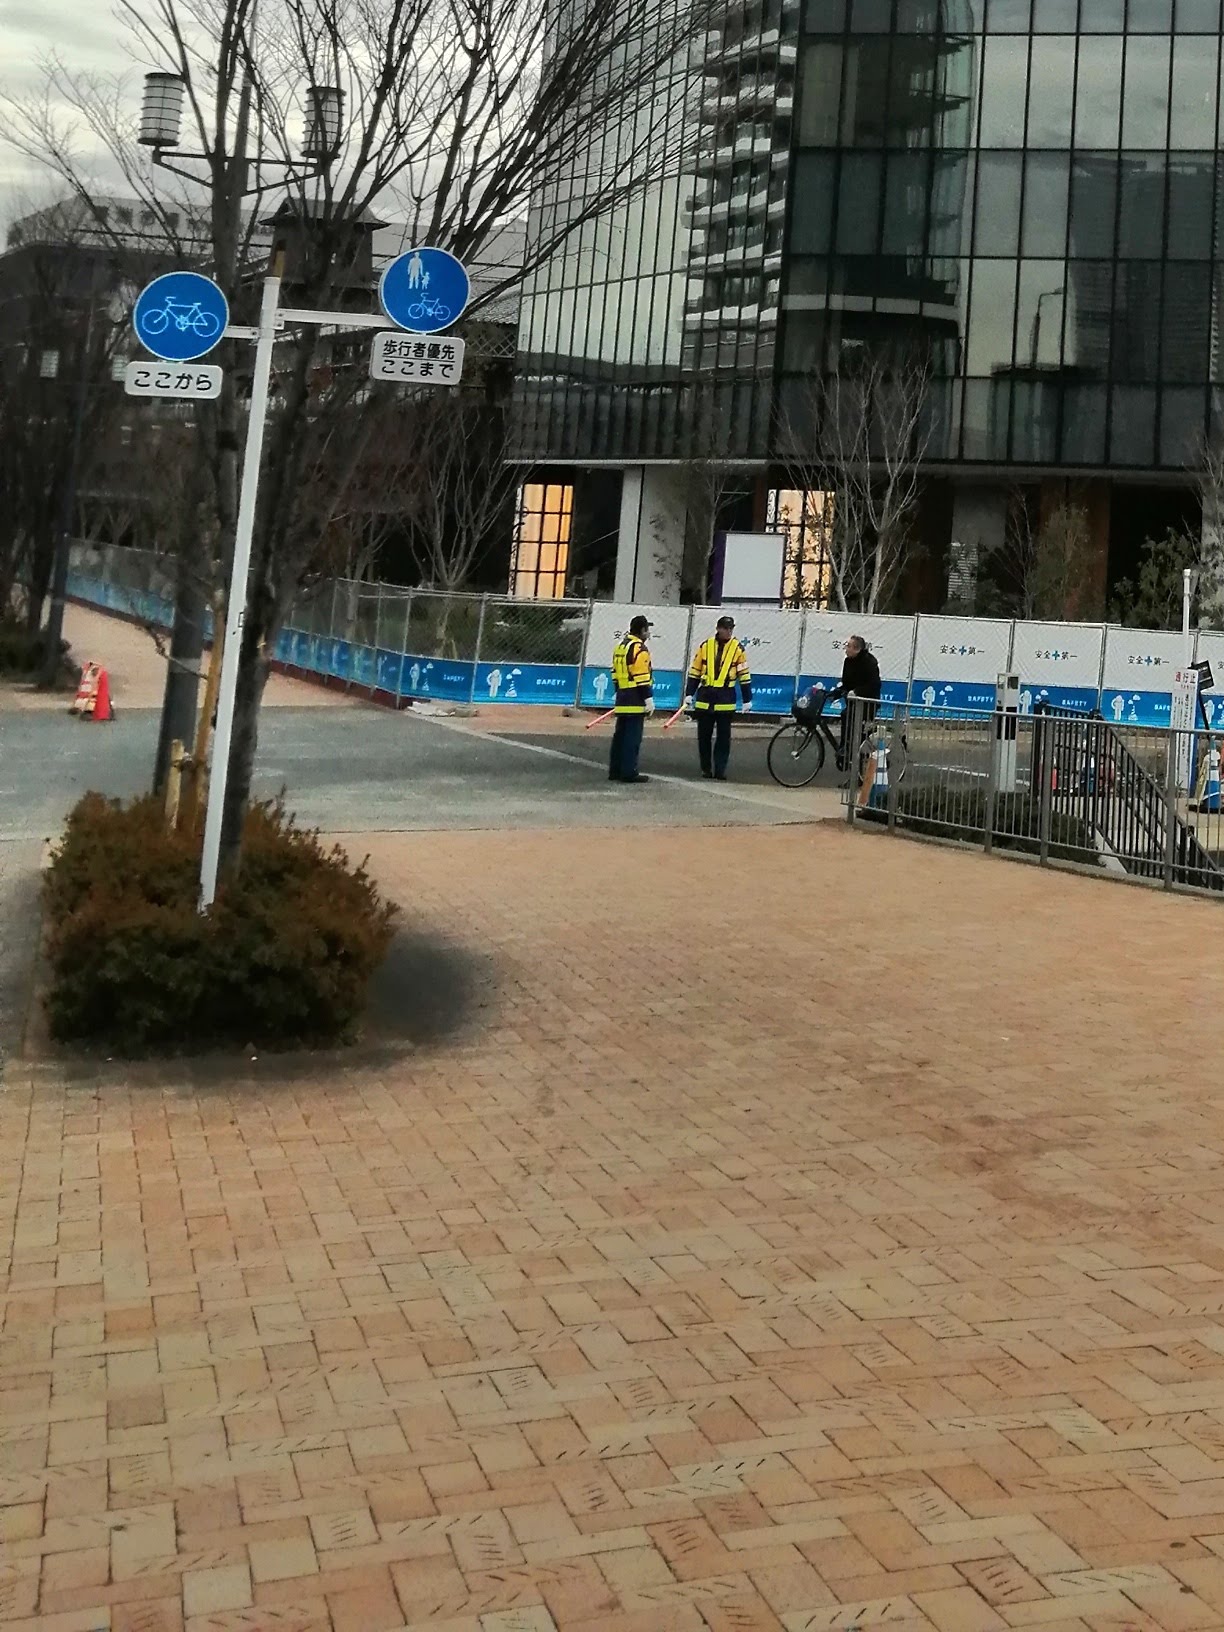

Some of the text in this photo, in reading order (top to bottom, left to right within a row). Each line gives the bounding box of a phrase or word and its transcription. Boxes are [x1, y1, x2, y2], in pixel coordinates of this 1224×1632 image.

[382, 339, 456, 360] 歩行者優先
[381, 358, 455, 379] ここまで
[133, 370, 213, 391] ここから
[536, 678, 566, 687] SAFETY
[751, 687, 782, 695] SAFETY
[968, 695, 995, 704] SAFETY
[1154, 703, 1171, 711] SAFE
